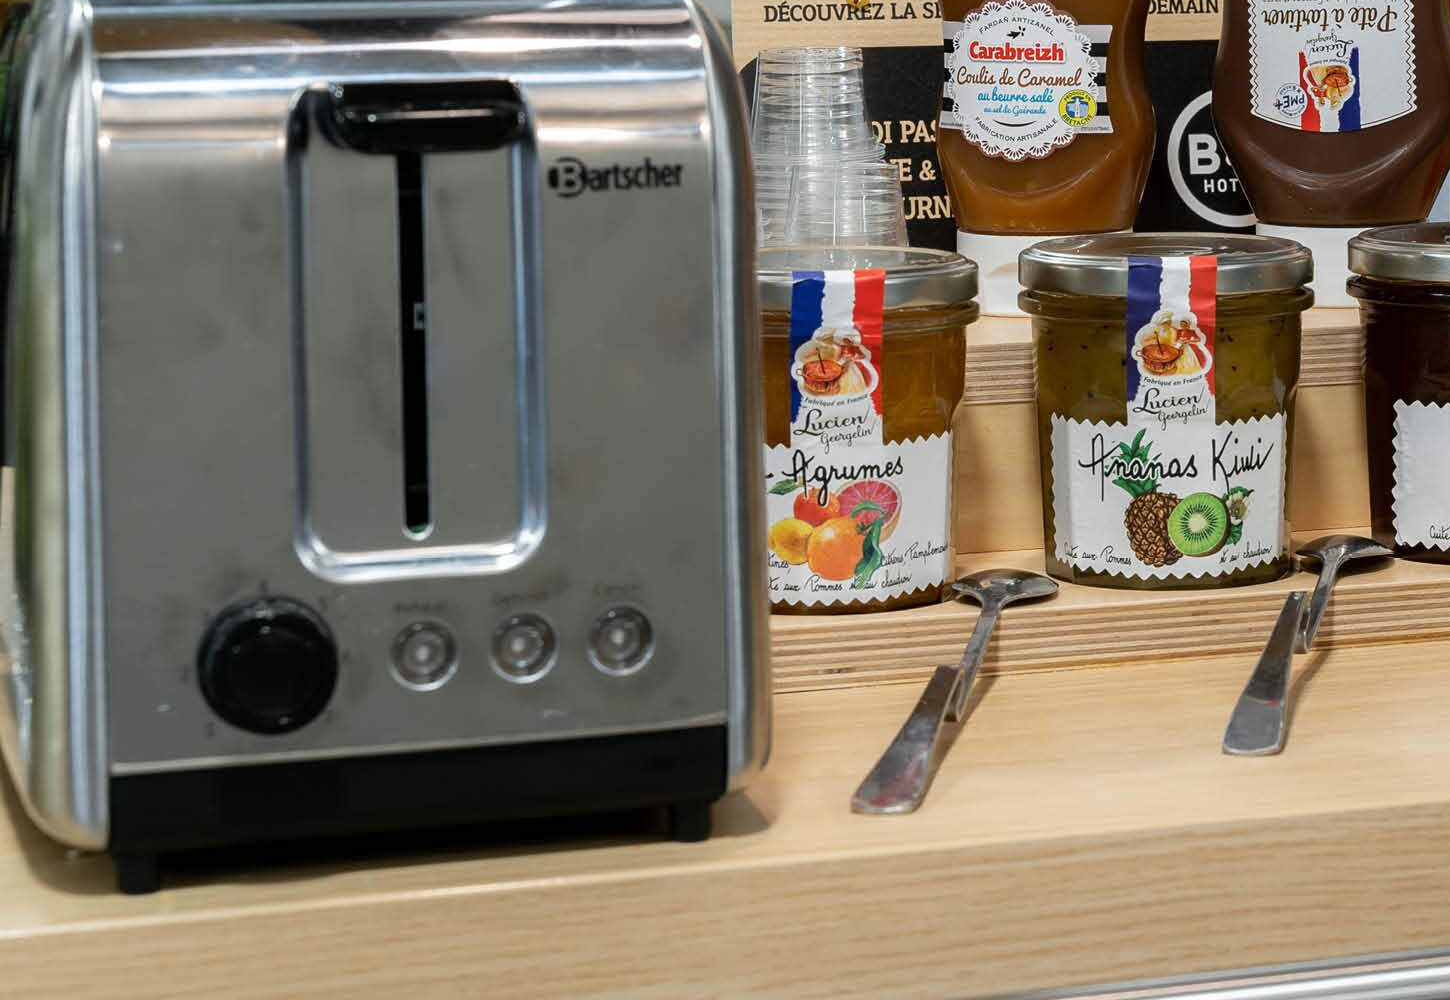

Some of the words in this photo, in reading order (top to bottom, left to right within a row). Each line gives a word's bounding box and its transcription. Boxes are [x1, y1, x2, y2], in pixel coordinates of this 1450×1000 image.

[763, 0, 885, 23] DÉCOUVREZ
[890, 2, 917, 20] LA
[1261, 8, 1330, 33] tartiner
[1331, 8, 1345, 29] à
[1347, 5, 1398, 33] Pâte
[969, 40, 1064, 61] Carabreizh
[1308, 38, 1354, 60] Lucien
[957, 65, 997, 85] Coulis
[998, 67, 1016, 85] de
[1017, 67, 1083, 88] Caramel
[977, 91, 989, 101] au
[990, 86, 1029, 102] beurre
[1029, 87, 1055, 103] salé
[1274, 93, 1305, 111] PME+
[975, 116, 1015, 142] FABRICATION
[1015, 118, 1058, 142] ARTISANALE
[548, 156, 684, 199] Bartscher
[919, 159, 937, 181] &
[1132, 386, 1204, 415] Lucien
[792, 407, 869, 436] Lucien
[1078, 432, 1199, 502] Ananas
[1212, 430, 1274, 494] Kiwi
[782, 449, 904, 507] Agrumes
[1429, 524, 1450, 541] Cuite
[1081, 552, 1097, 560] aux
[1099, 545, 1132, 565] Pommes
[783, 582, 801, 591] aux
[803, 574, 843, 592] Pommes
